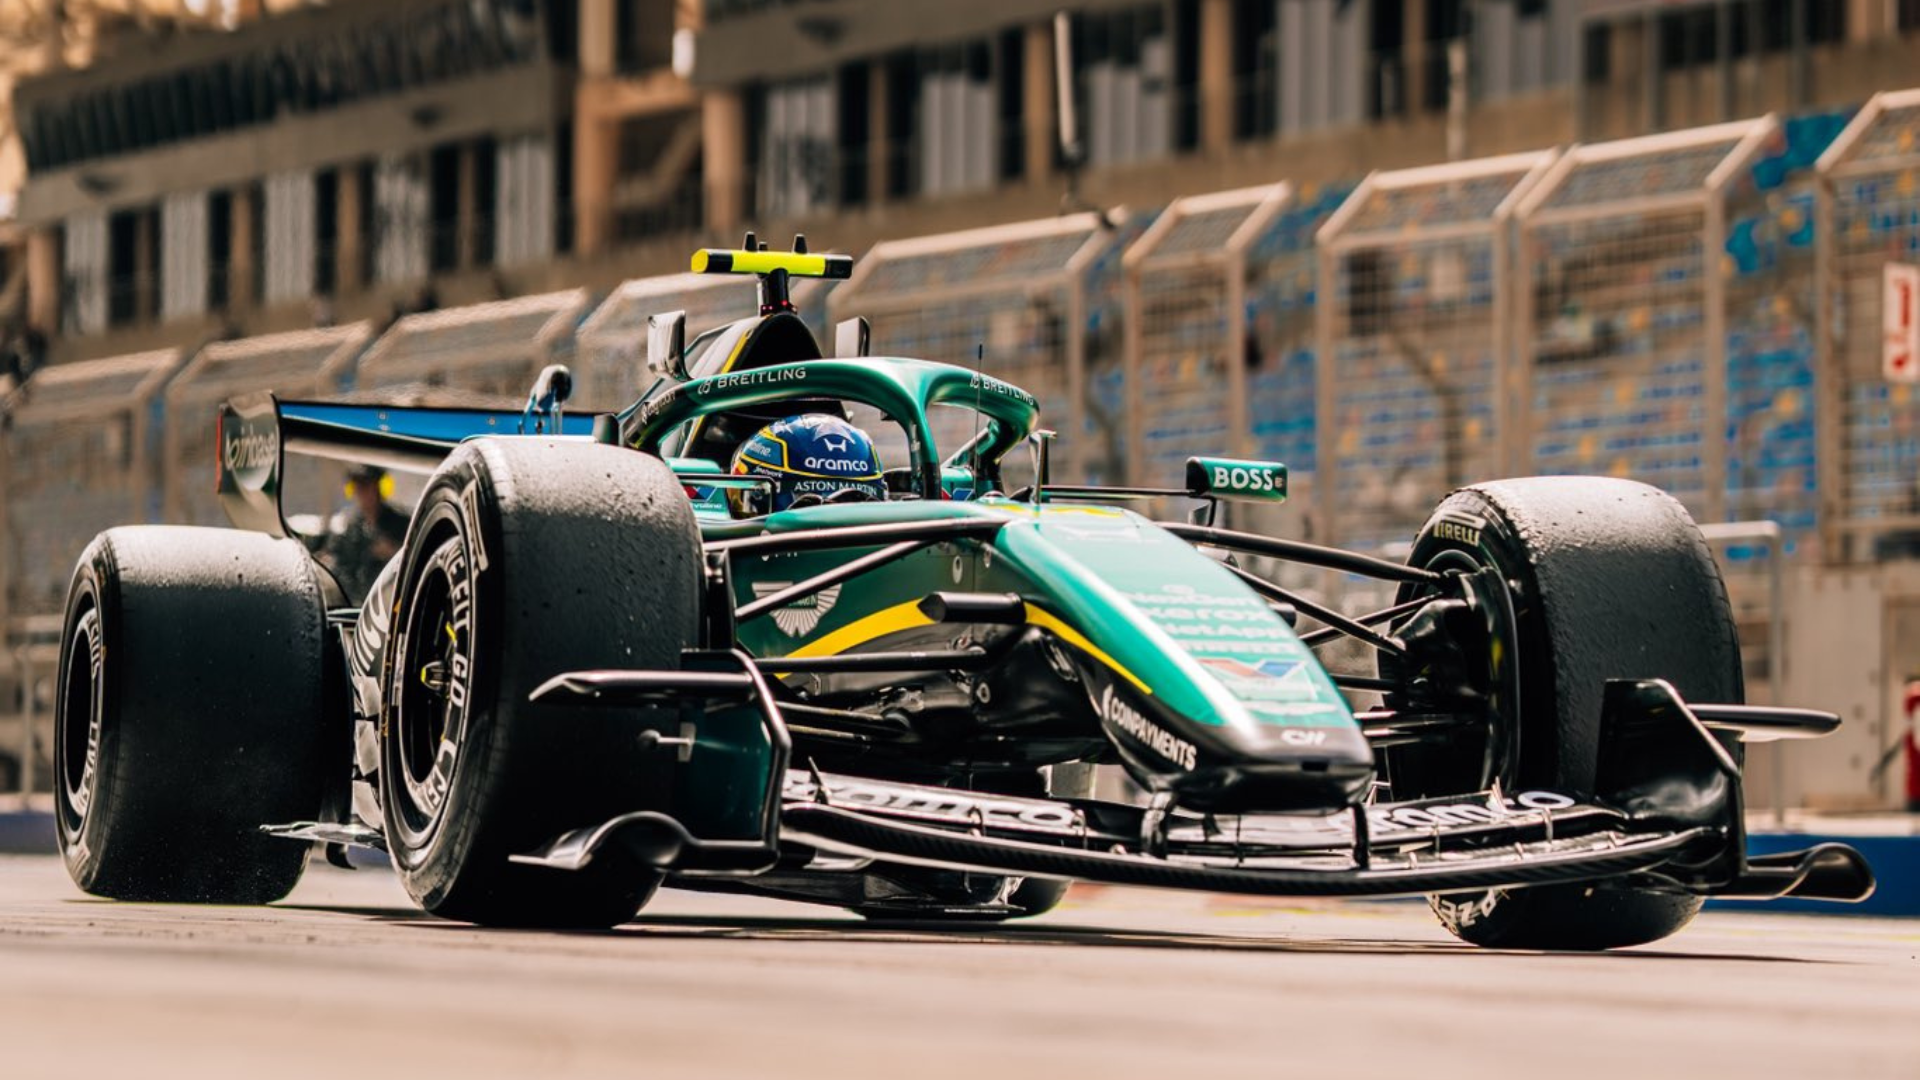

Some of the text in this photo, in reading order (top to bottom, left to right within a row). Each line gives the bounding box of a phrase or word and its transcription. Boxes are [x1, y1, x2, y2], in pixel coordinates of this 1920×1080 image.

[717, 367, 806, 389] BREITLING
[983, 377, 1034, 406] BREITLING
[804, 456, 869, 472] aramco
[794, 481, 836, 492] ASTON
[1213, 466, 1273, 491] BOSS
[1433, 510, 1486, 547] PIRELLI
[1111, 697, 1197, 771] COINPAYMENTS
